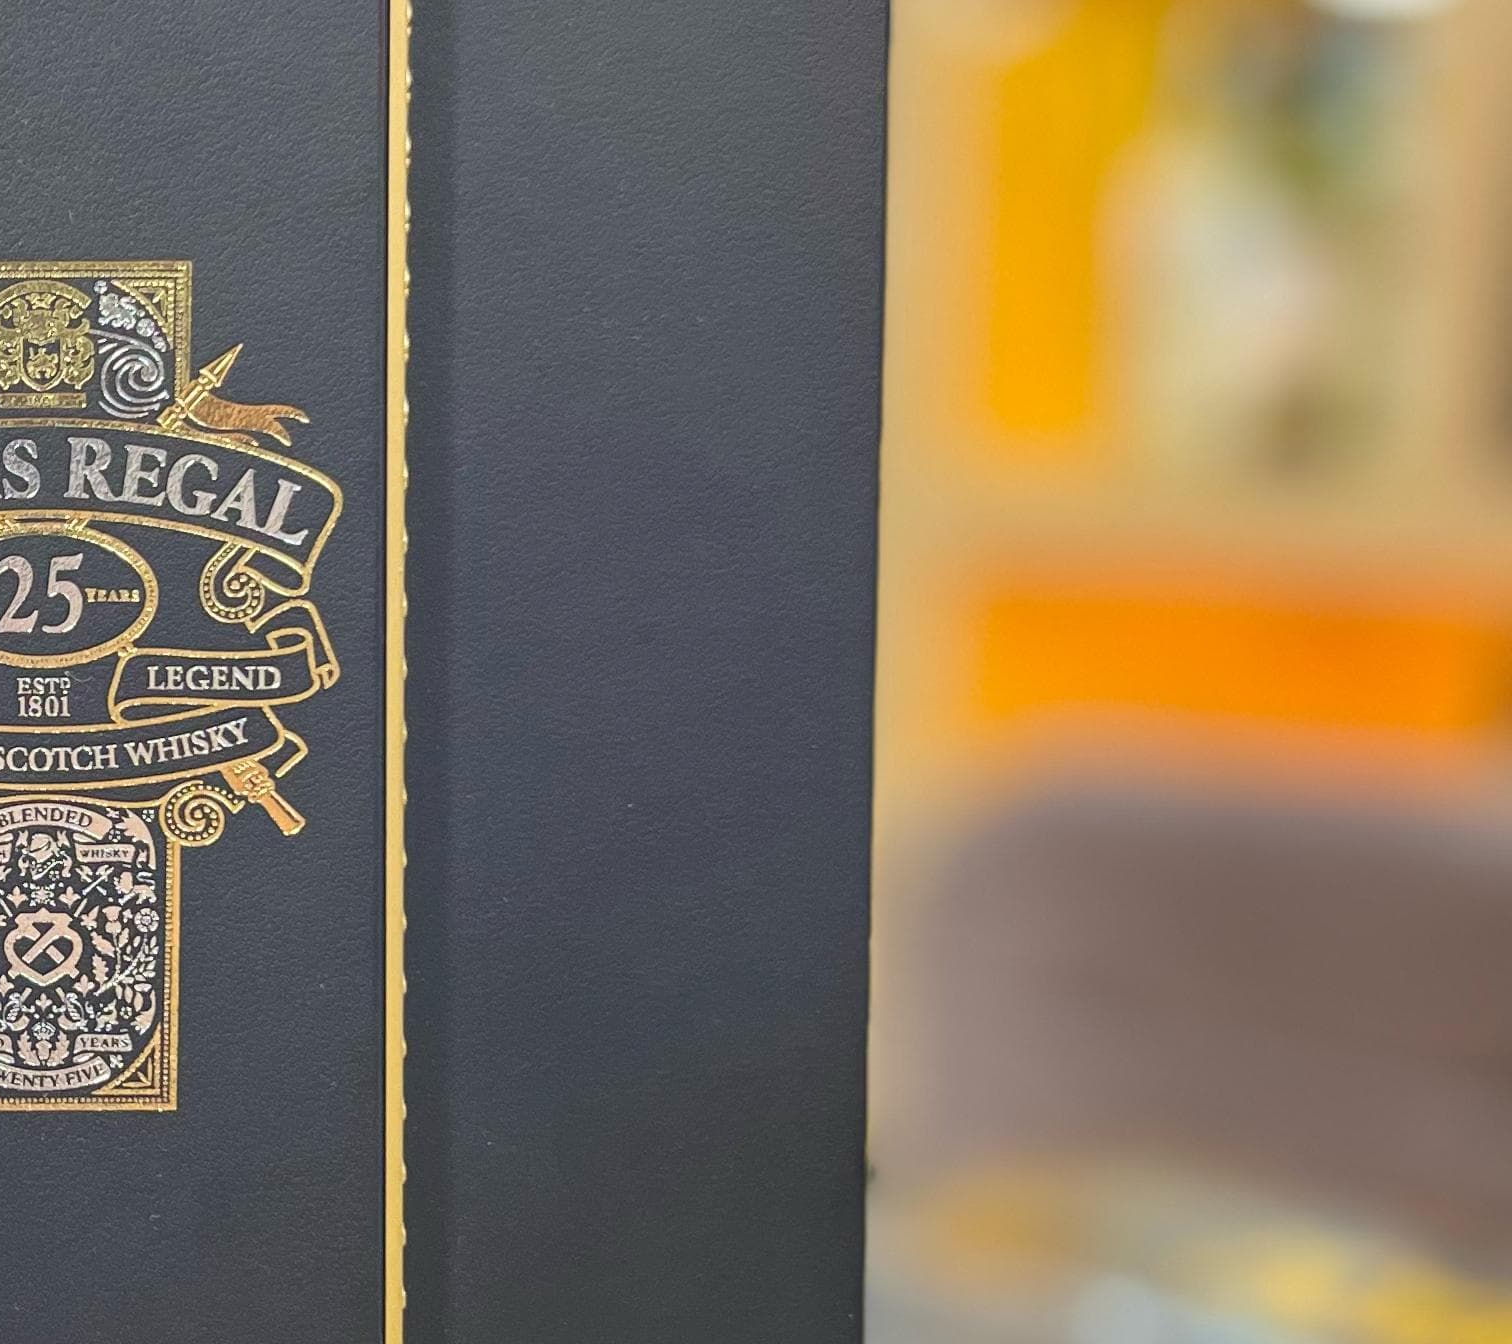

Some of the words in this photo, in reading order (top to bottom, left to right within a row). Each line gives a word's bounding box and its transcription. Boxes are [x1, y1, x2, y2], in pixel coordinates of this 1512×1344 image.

[64, 437, 308, 545] REGAL
[85, 588, 140, 603] YEARS
[147, 666, 281, 691] LEGEND
[17, 695, 71, 717] 1801
[123, 718, 249, 766] WHISKY
[80, 849, 129, 859] WHISKY
[80, 1037, 129, 1049] YEARS
[66, 1062, 104, 1086] FIVE
